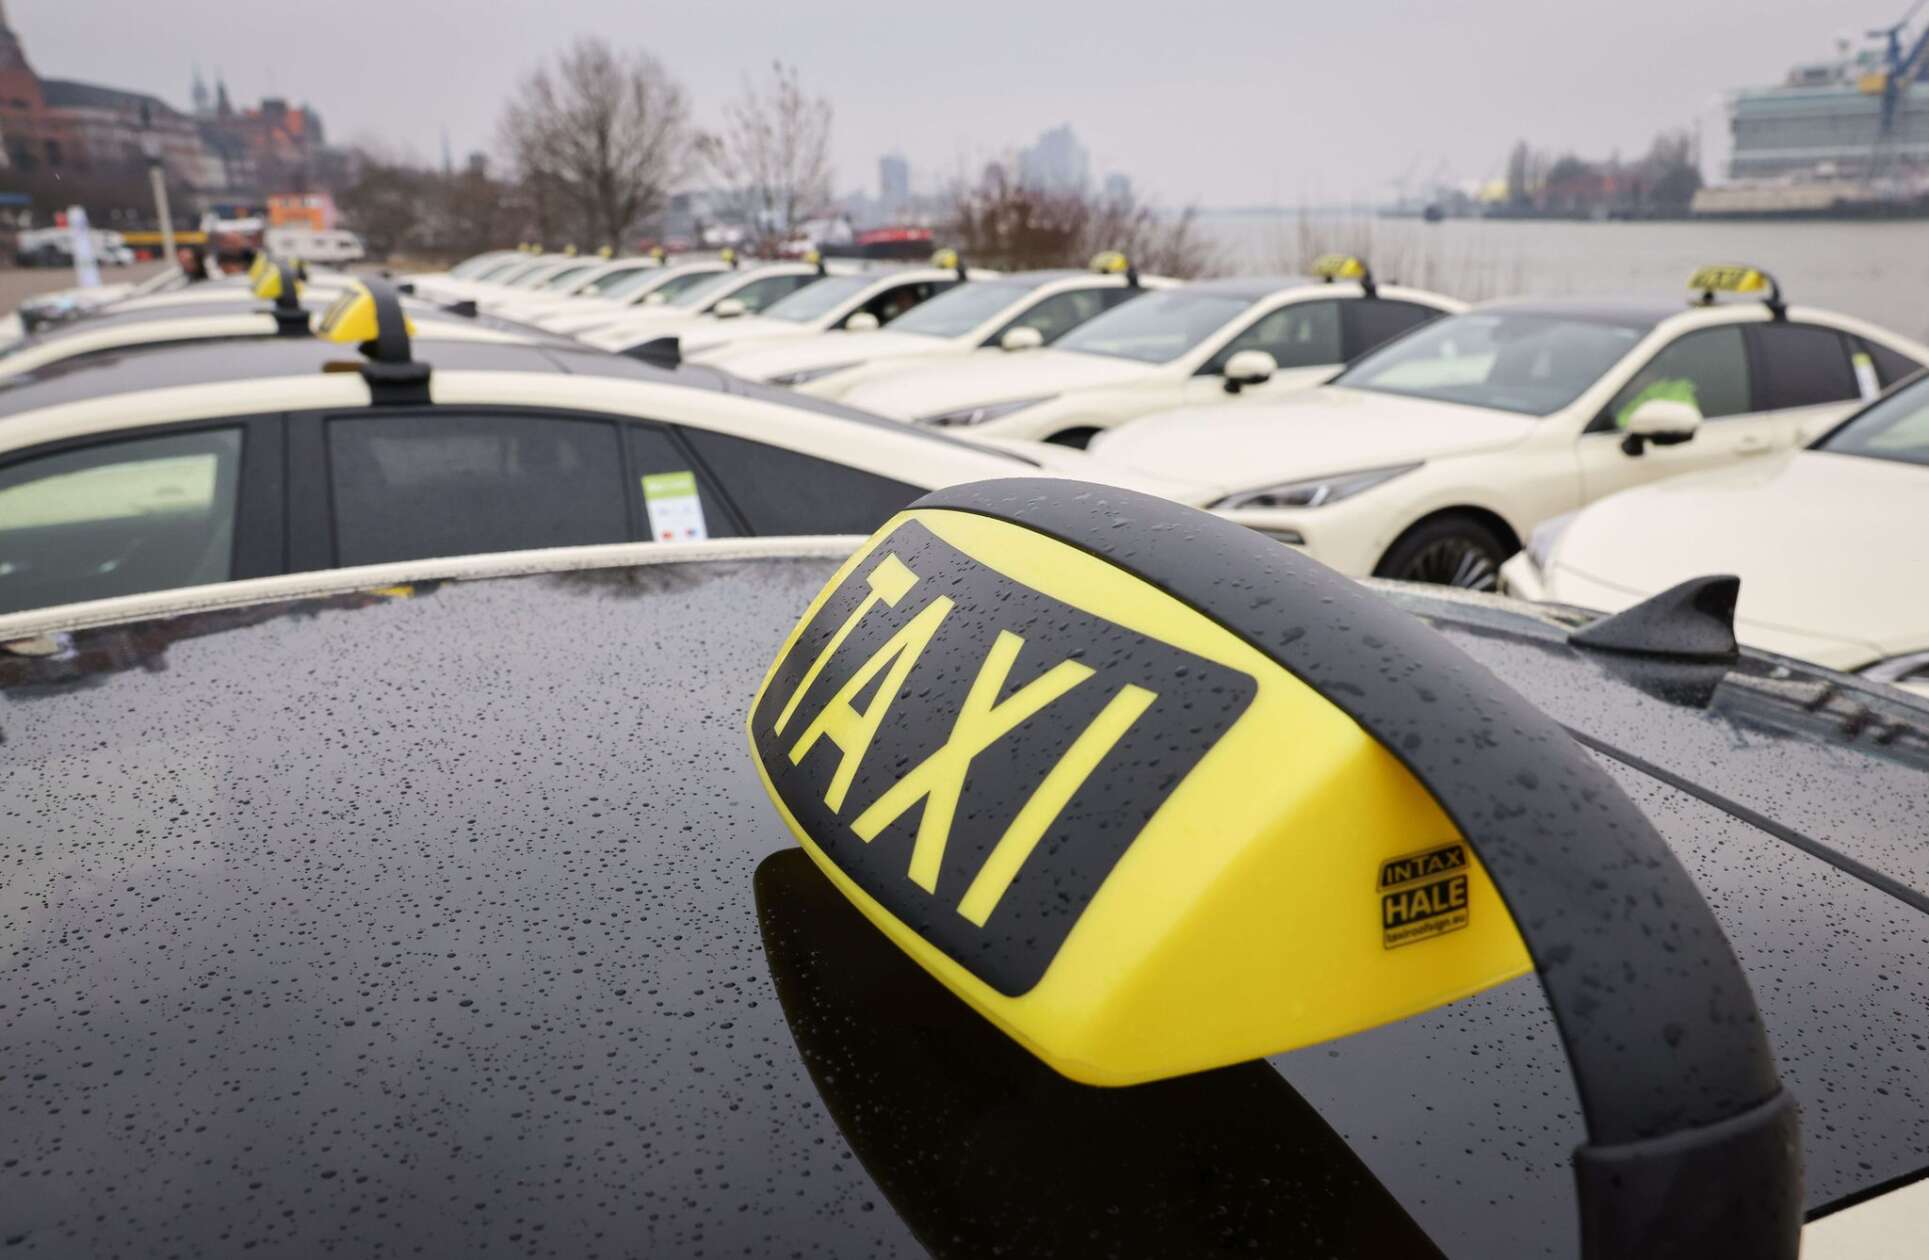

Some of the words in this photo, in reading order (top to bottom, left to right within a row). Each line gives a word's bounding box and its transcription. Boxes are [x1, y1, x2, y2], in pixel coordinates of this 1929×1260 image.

[774, 552, 1159, 929] TAXI
[1385, 849, 1461, 884] INTAX
[1385, 877, 1466, 926] HALE
